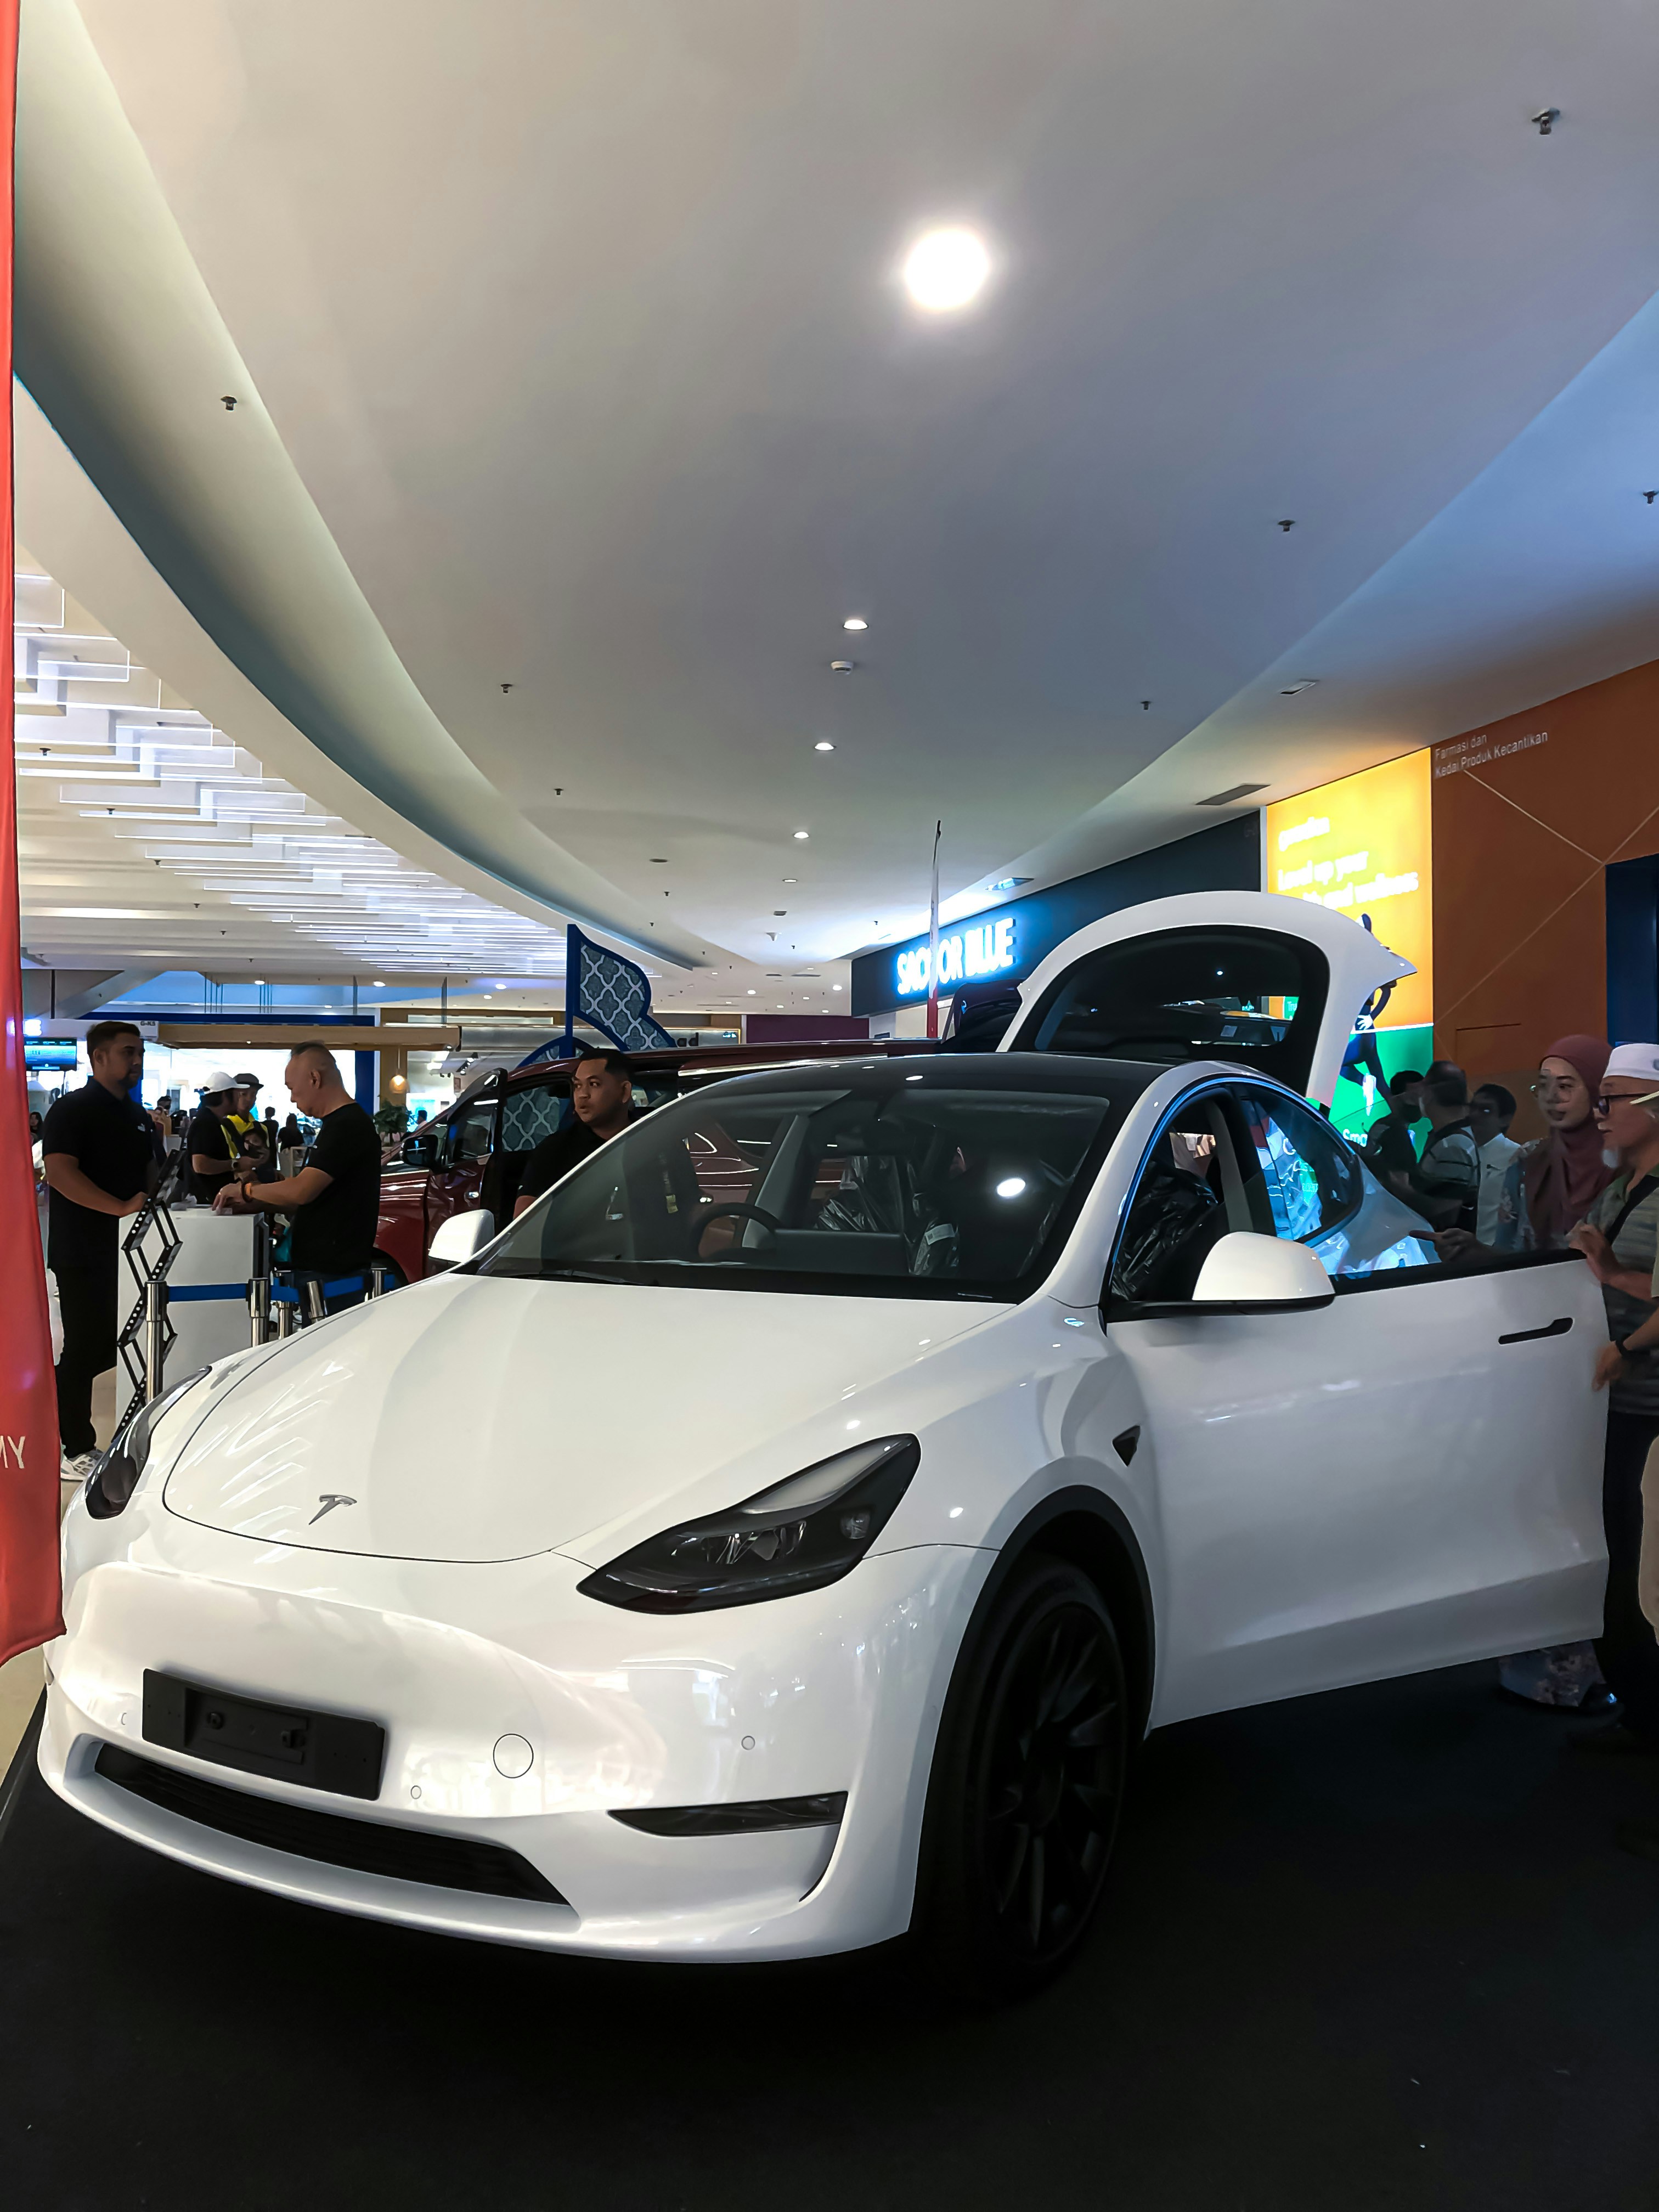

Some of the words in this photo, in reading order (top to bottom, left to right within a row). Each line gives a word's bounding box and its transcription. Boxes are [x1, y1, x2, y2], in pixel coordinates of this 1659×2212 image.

[1435, 741, 1469, 760] Farmasi
[1471, 734, 1487, 748] dan
[1435, 763, 1459, 777] Kedai
[1461, 749, 1492, 769] Produk
[1494, 732, 1548, 758] Kecantikan
